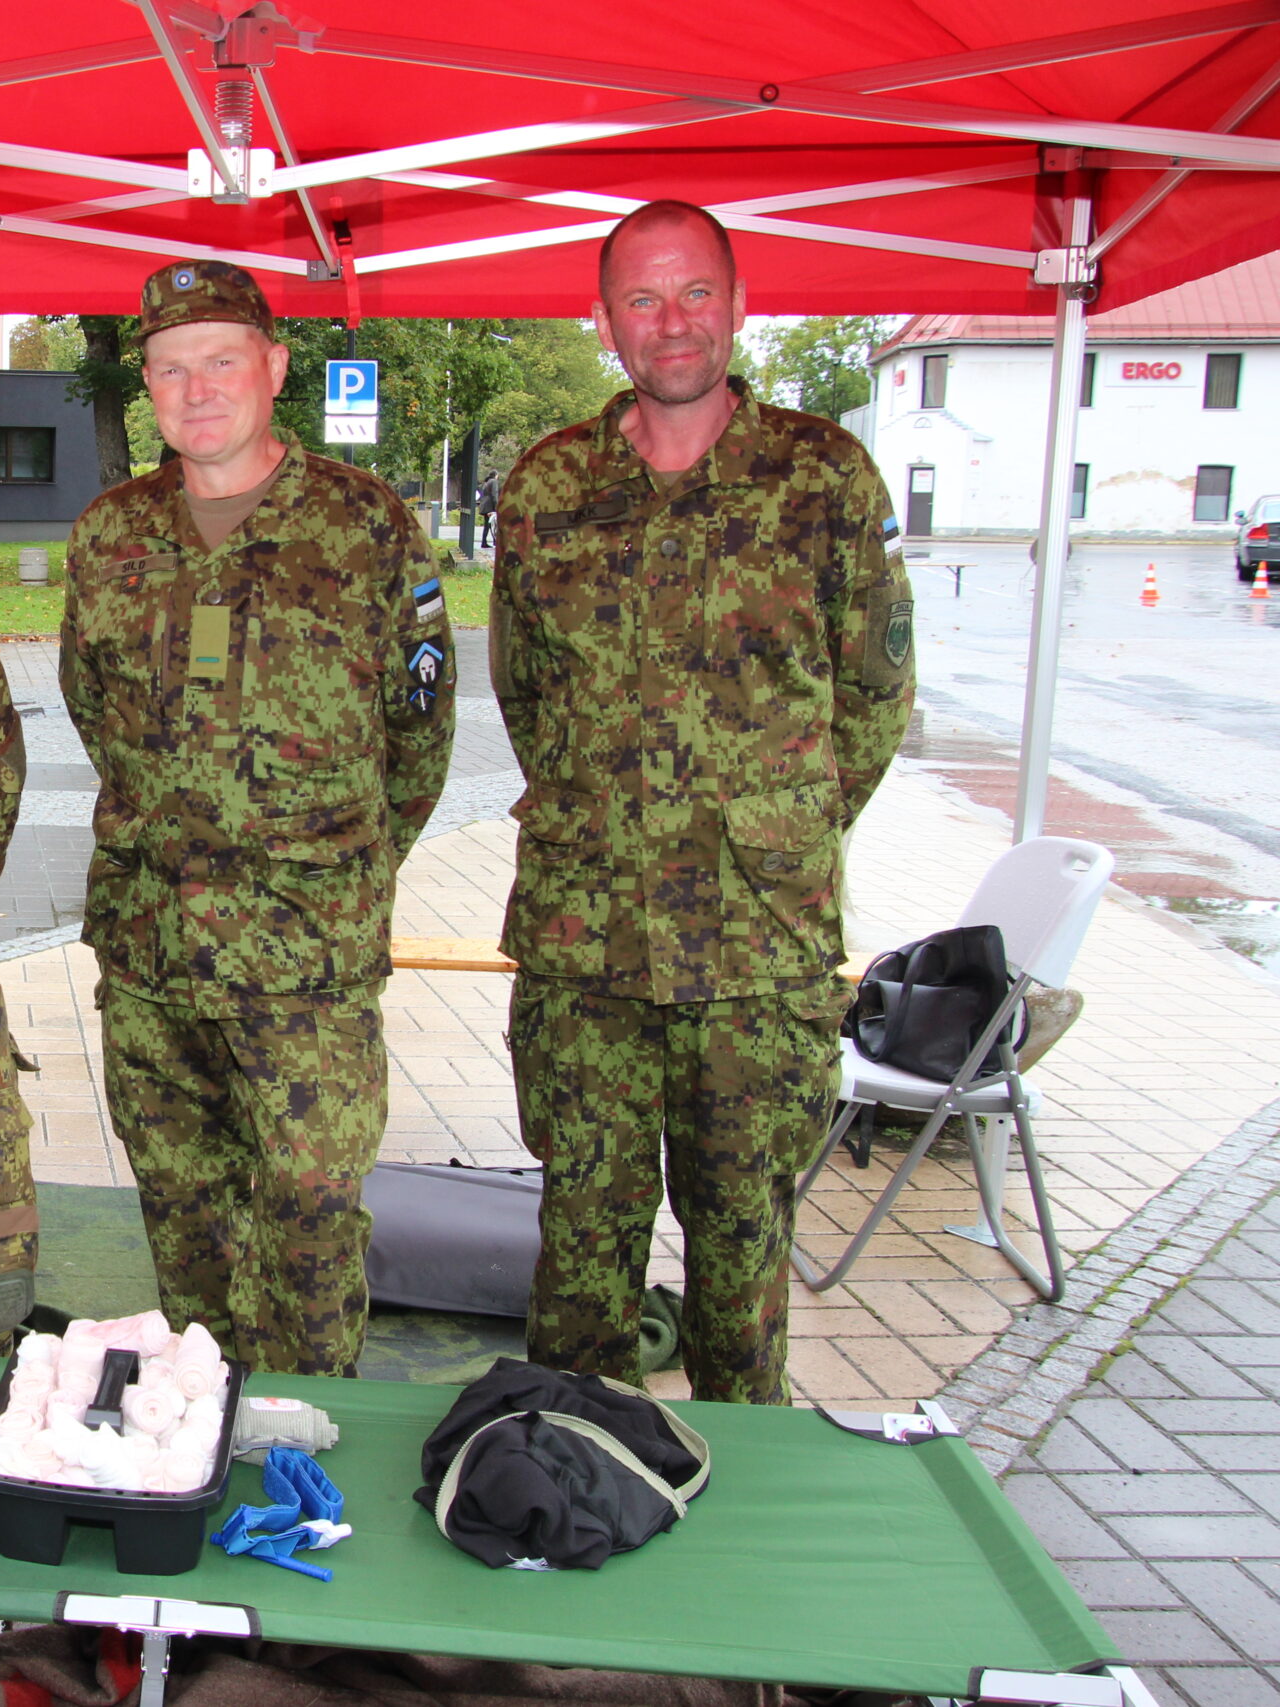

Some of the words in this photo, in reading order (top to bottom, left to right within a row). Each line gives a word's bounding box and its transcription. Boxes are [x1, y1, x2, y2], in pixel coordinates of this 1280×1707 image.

[1122, 361, 1182, 380] ERGO
[339, 367, 365, 406] P
[121, 559, 146, 573] SILD
